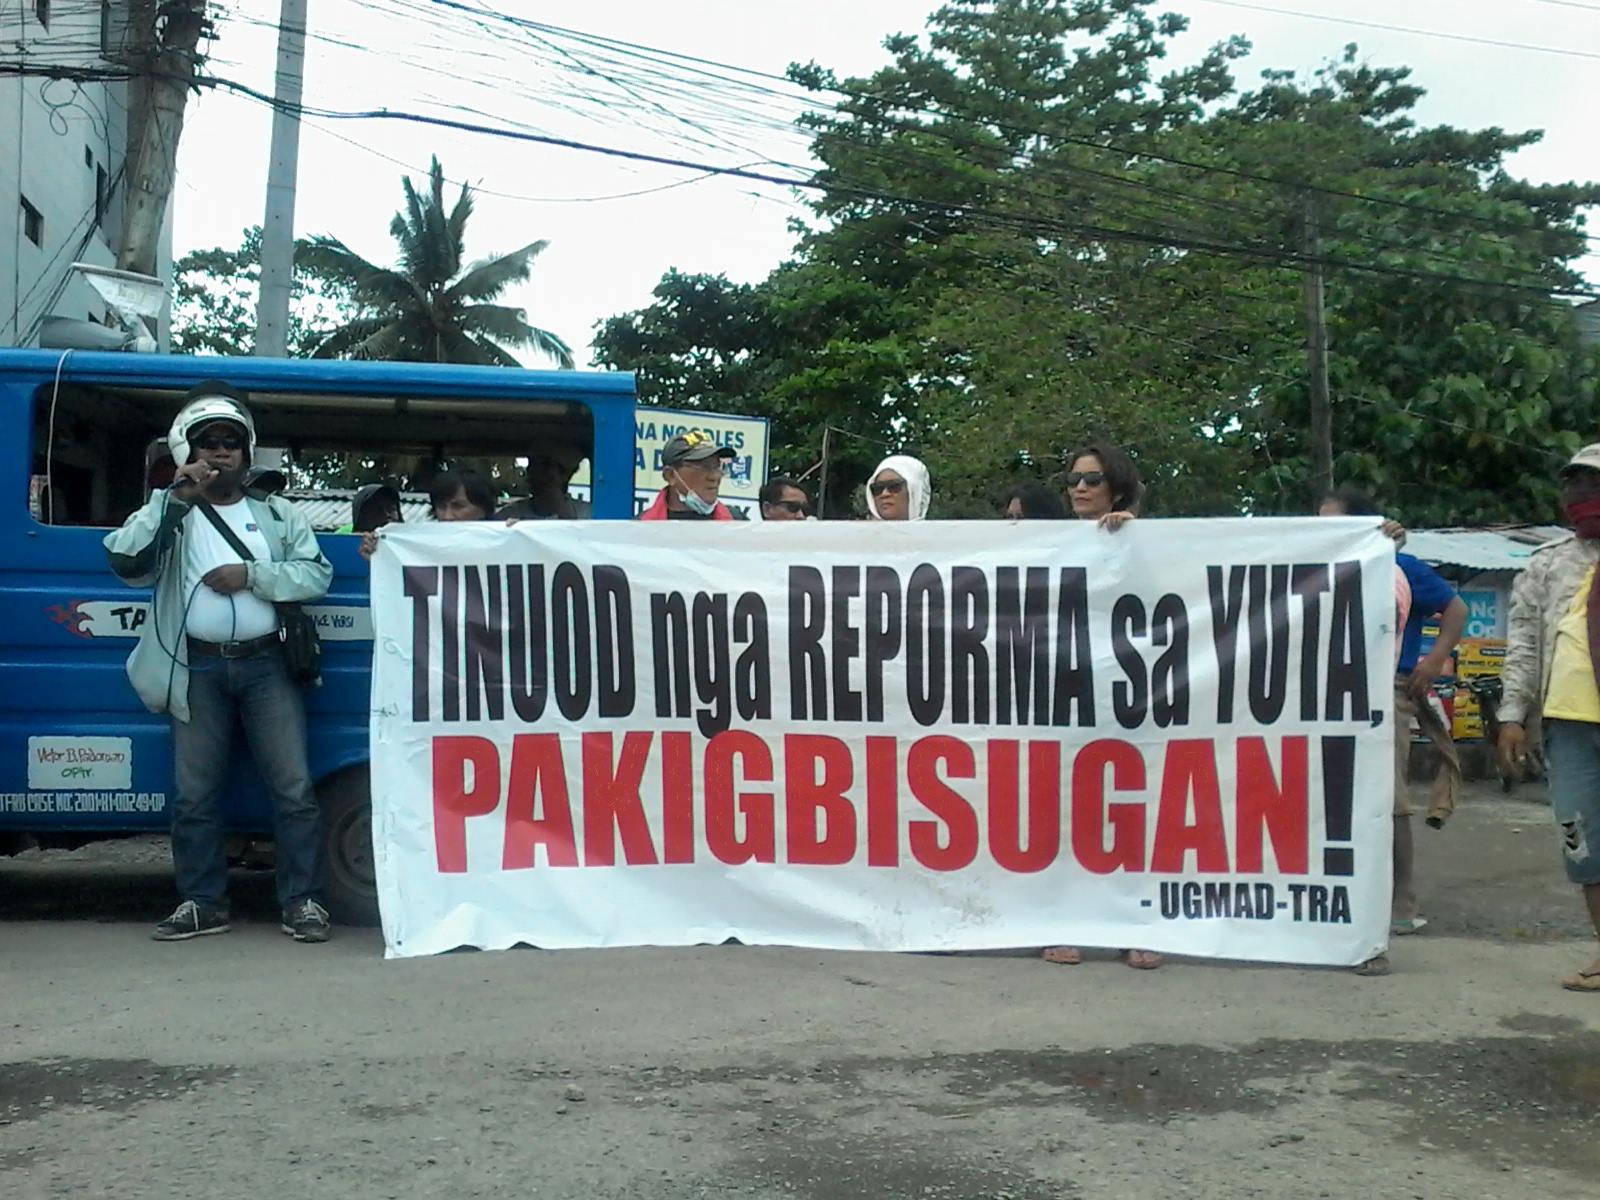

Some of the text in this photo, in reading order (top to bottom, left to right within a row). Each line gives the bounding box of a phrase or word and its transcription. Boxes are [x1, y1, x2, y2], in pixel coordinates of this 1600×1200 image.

[403, 560, 1383, 739] TINUOD nga REPORMA sa YUTA,
[432, 730, 1356, 876] PAKIGBISUGAN!
[1160, 881, 1352, 924] UGMAD-TRA
